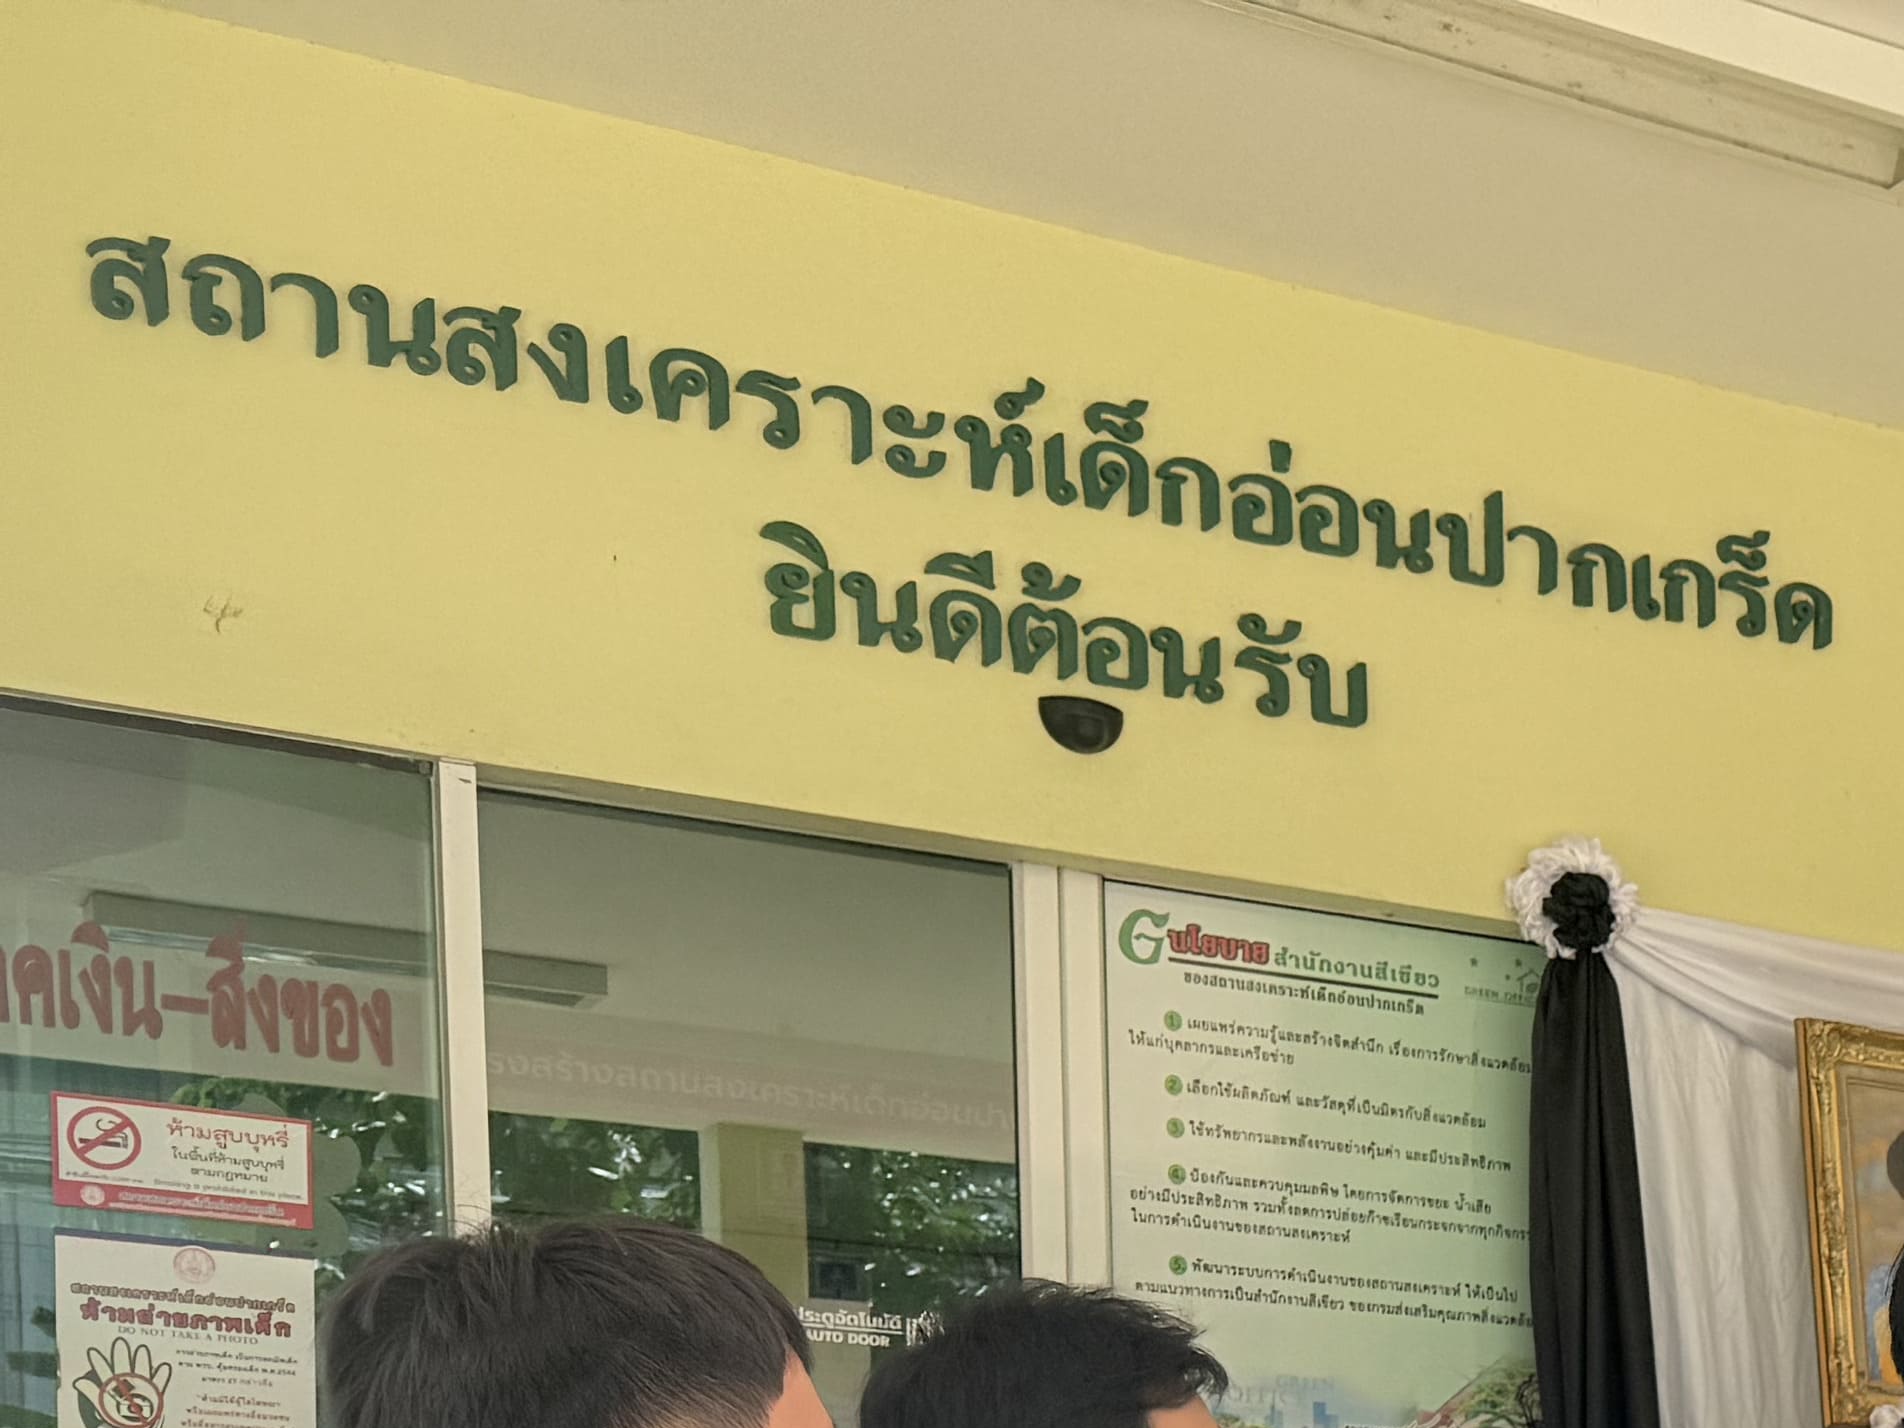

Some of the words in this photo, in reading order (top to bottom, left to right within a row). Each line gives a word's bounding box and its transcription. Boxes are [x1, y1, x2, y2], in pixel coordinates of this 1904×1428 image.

[85, 234, 1835, 652] สถานสงเคราะห์เด็กอ่อนปากเกร็ด
[761, 518, 1369, 730] ยินดีต้อนรับ
[1166, 922, 1270, 966] นโยบาย
[1274, 946, 1440, 989] สำนักงานสีเขียว
[166, 1115, 290, 1153] ห้ามสูบบุหรี่
[80, 1296, 292, 1338] ห้ามถ่ายภาพเด็ก
[848, 1332, 890, 1347] DOOR
